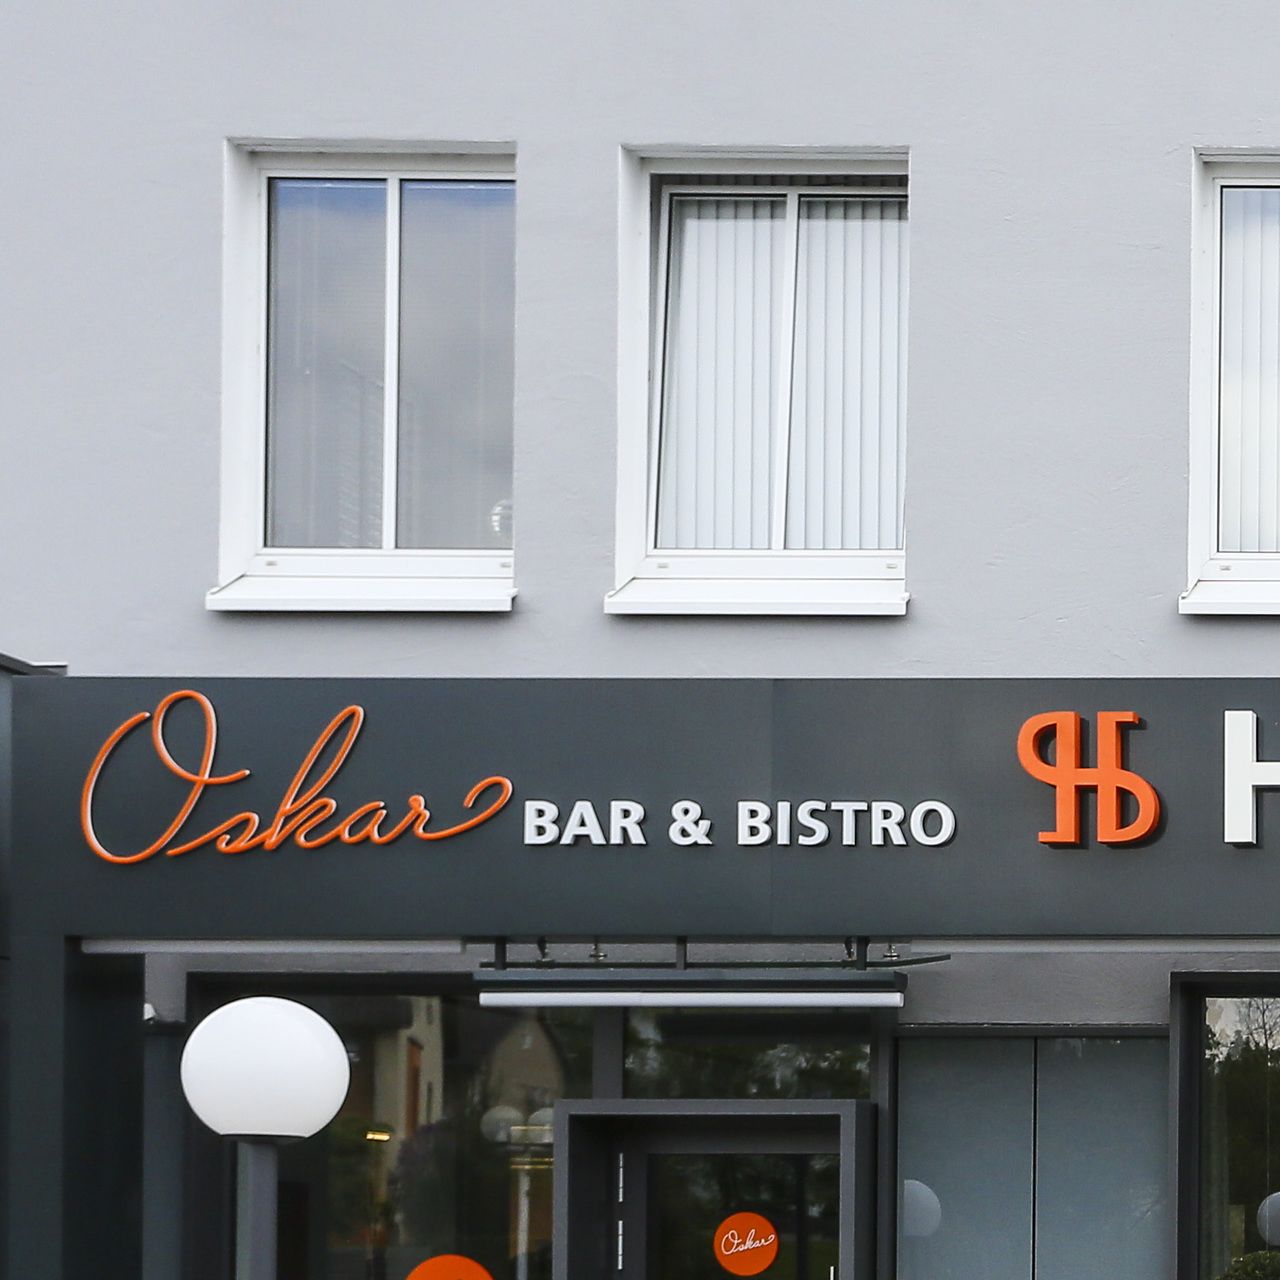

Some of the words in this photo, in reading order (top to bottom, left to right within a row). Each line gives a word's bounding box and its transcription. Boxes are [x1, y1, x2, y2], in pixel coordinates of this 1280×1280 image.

[81, 690, 512, 865] Oskar
[523, 800, 648, 846] BAR
[668, 800, 713, 846] &
[737, 800, 957, 847] BISTRO
[721, 1229, 776, 1255] Oskar
